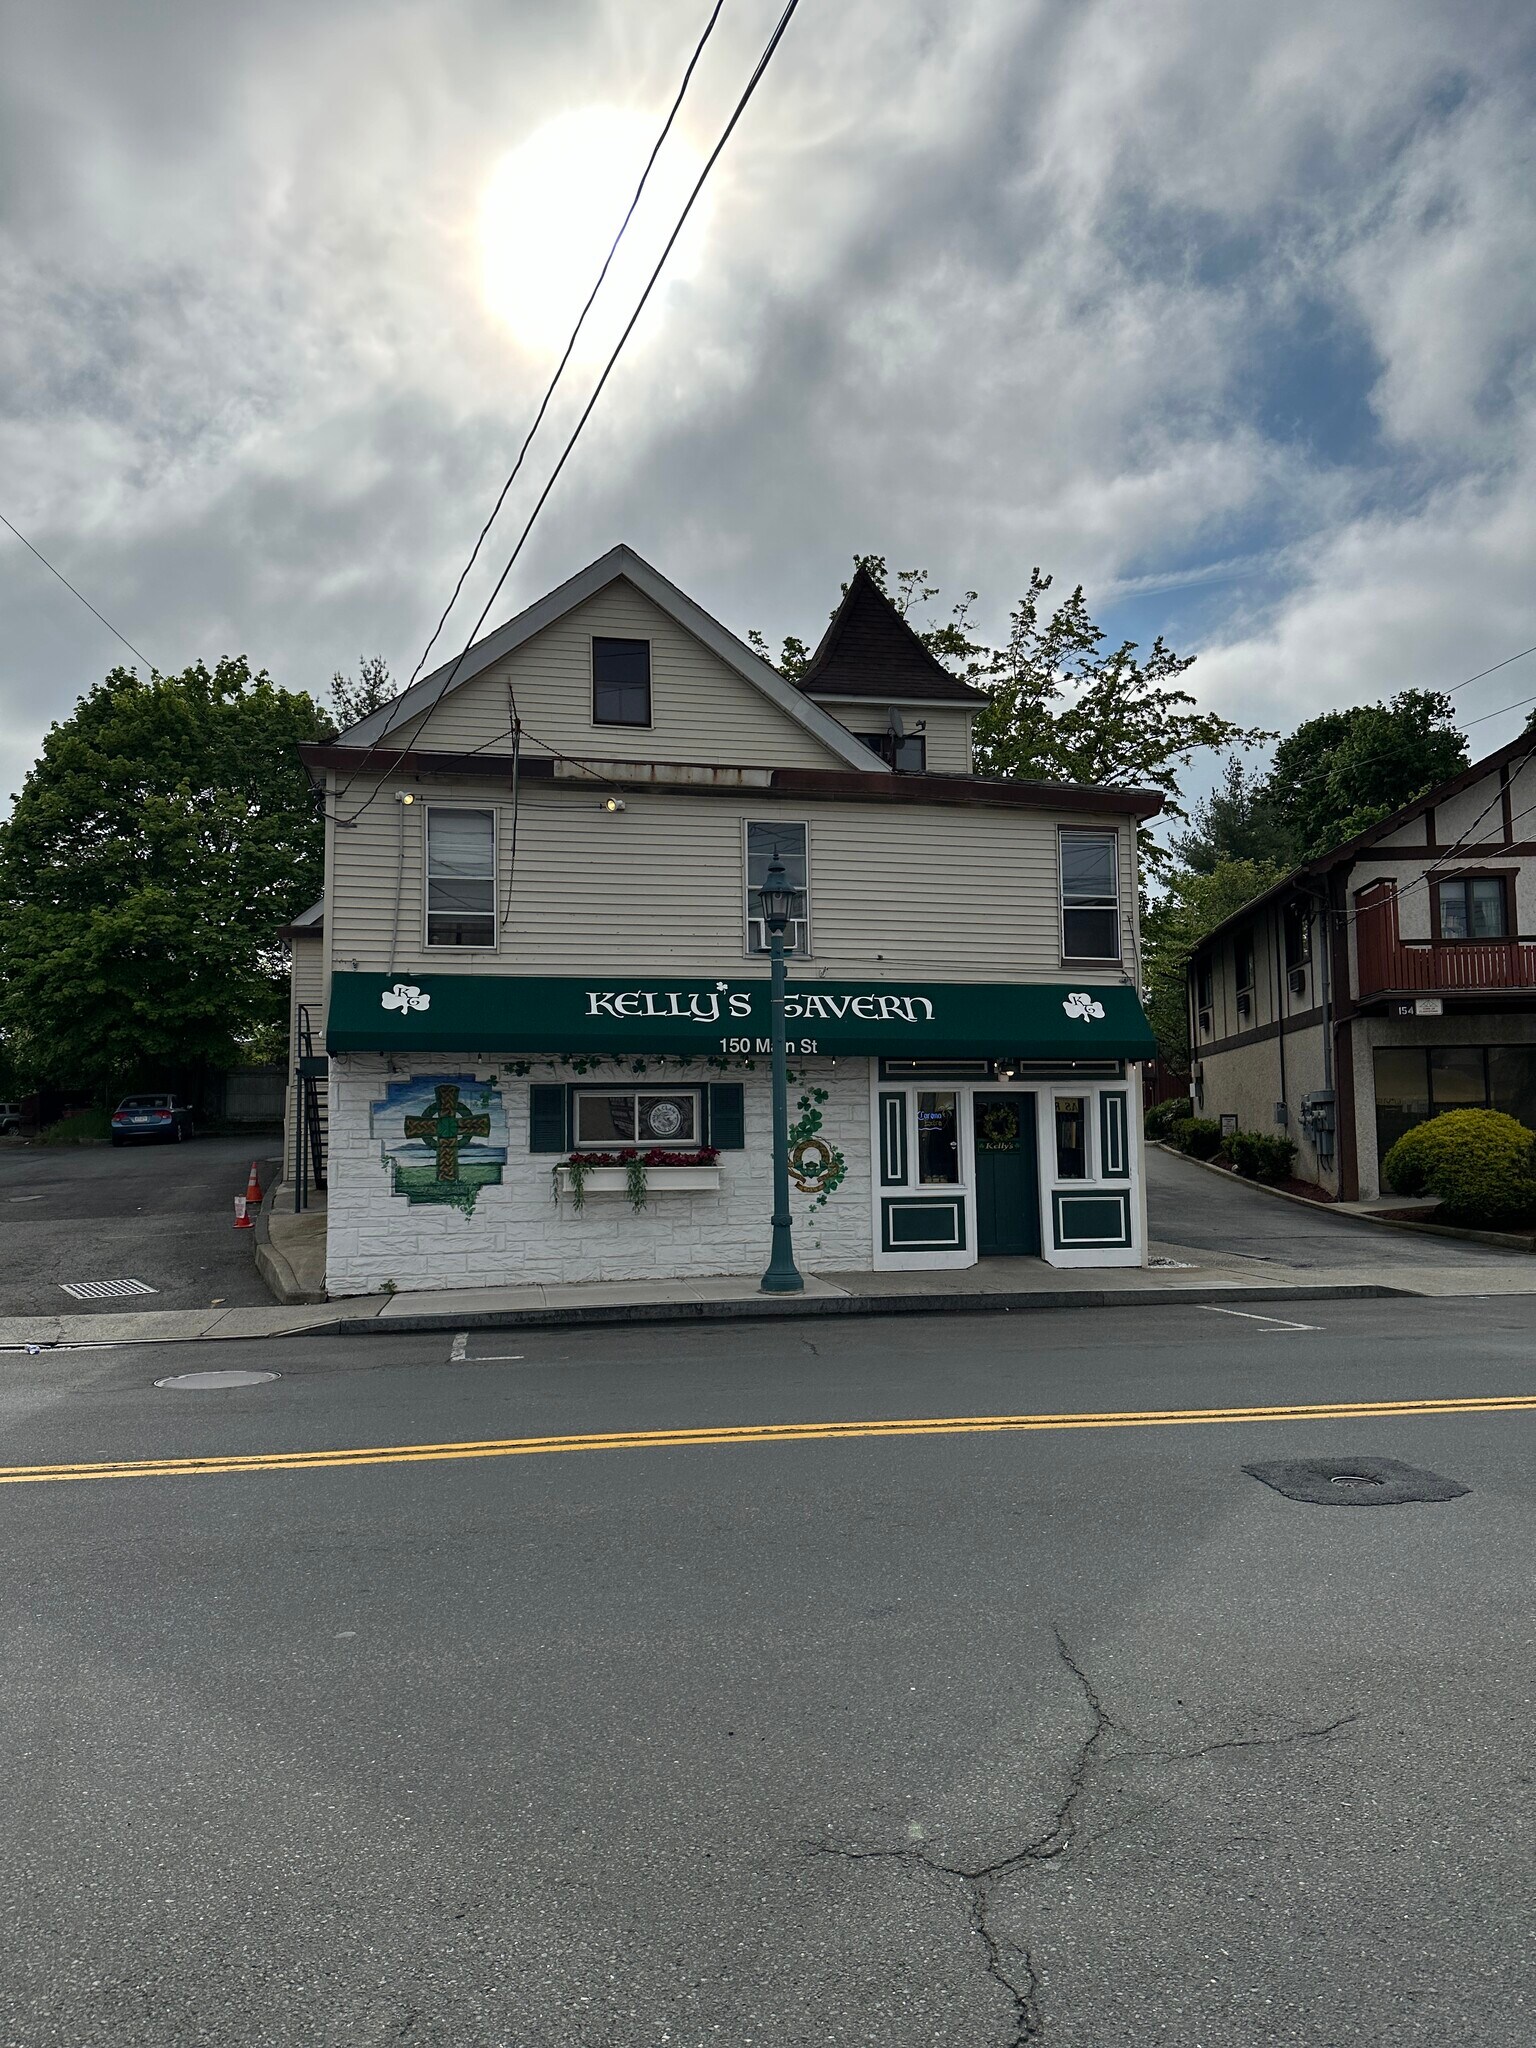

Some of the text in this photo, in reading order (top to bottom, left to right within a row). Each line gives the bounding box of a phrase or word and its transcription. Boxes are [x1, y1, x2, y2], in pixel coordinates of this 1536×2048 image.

[1398, 1006, 1414, 1016] 154
[719, 1037, 818, 1054] 150 Mn St
[917, 1110, 942, 1121] Corona
[985, 1141, 1014, 1152] Kelly's
